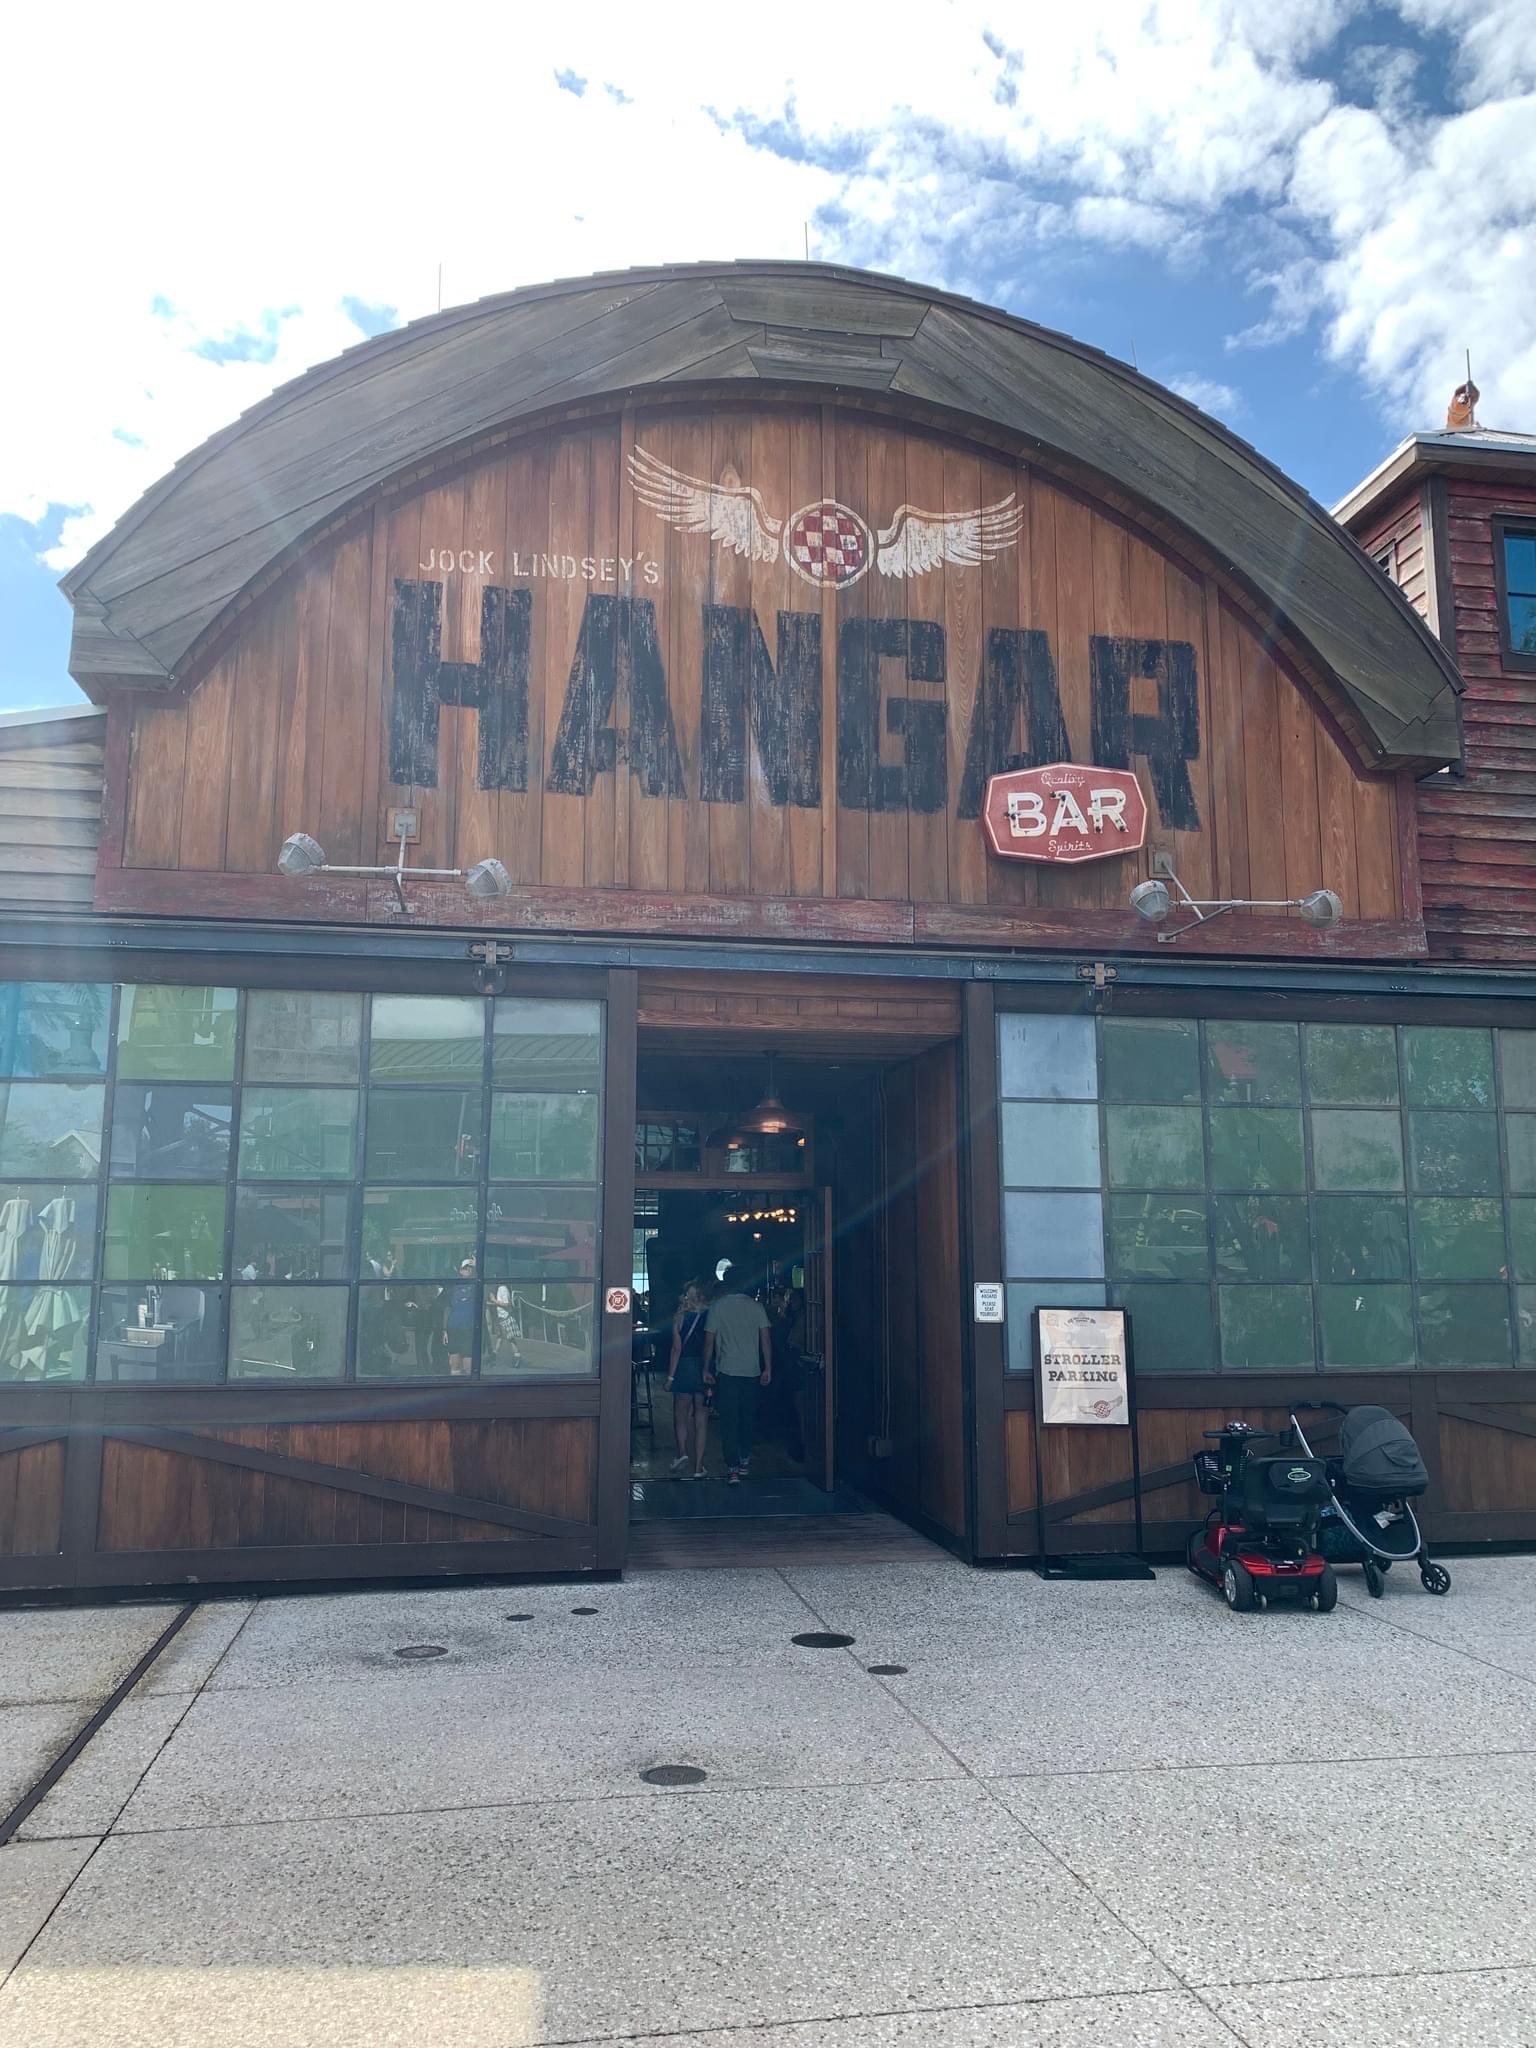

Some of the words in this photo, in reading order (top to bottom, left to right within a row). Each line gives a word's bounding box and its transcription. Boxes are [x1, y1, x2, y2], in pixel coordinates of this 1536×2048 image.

[419, 548, 494, 575] JOCK
[513, 551, 659, 584] LINDSEY'S
[388, 578, 1201, 832] HANGAR
[1041, 771, 1086, 787] Quality
[1007, 788, 1129, 837] BAR
[1048, 839, 1093, 855] Spirits
[1044, 1354, 1121, 1366] STROLLER
[1048, 1371, 1119, 1382] PARKING
